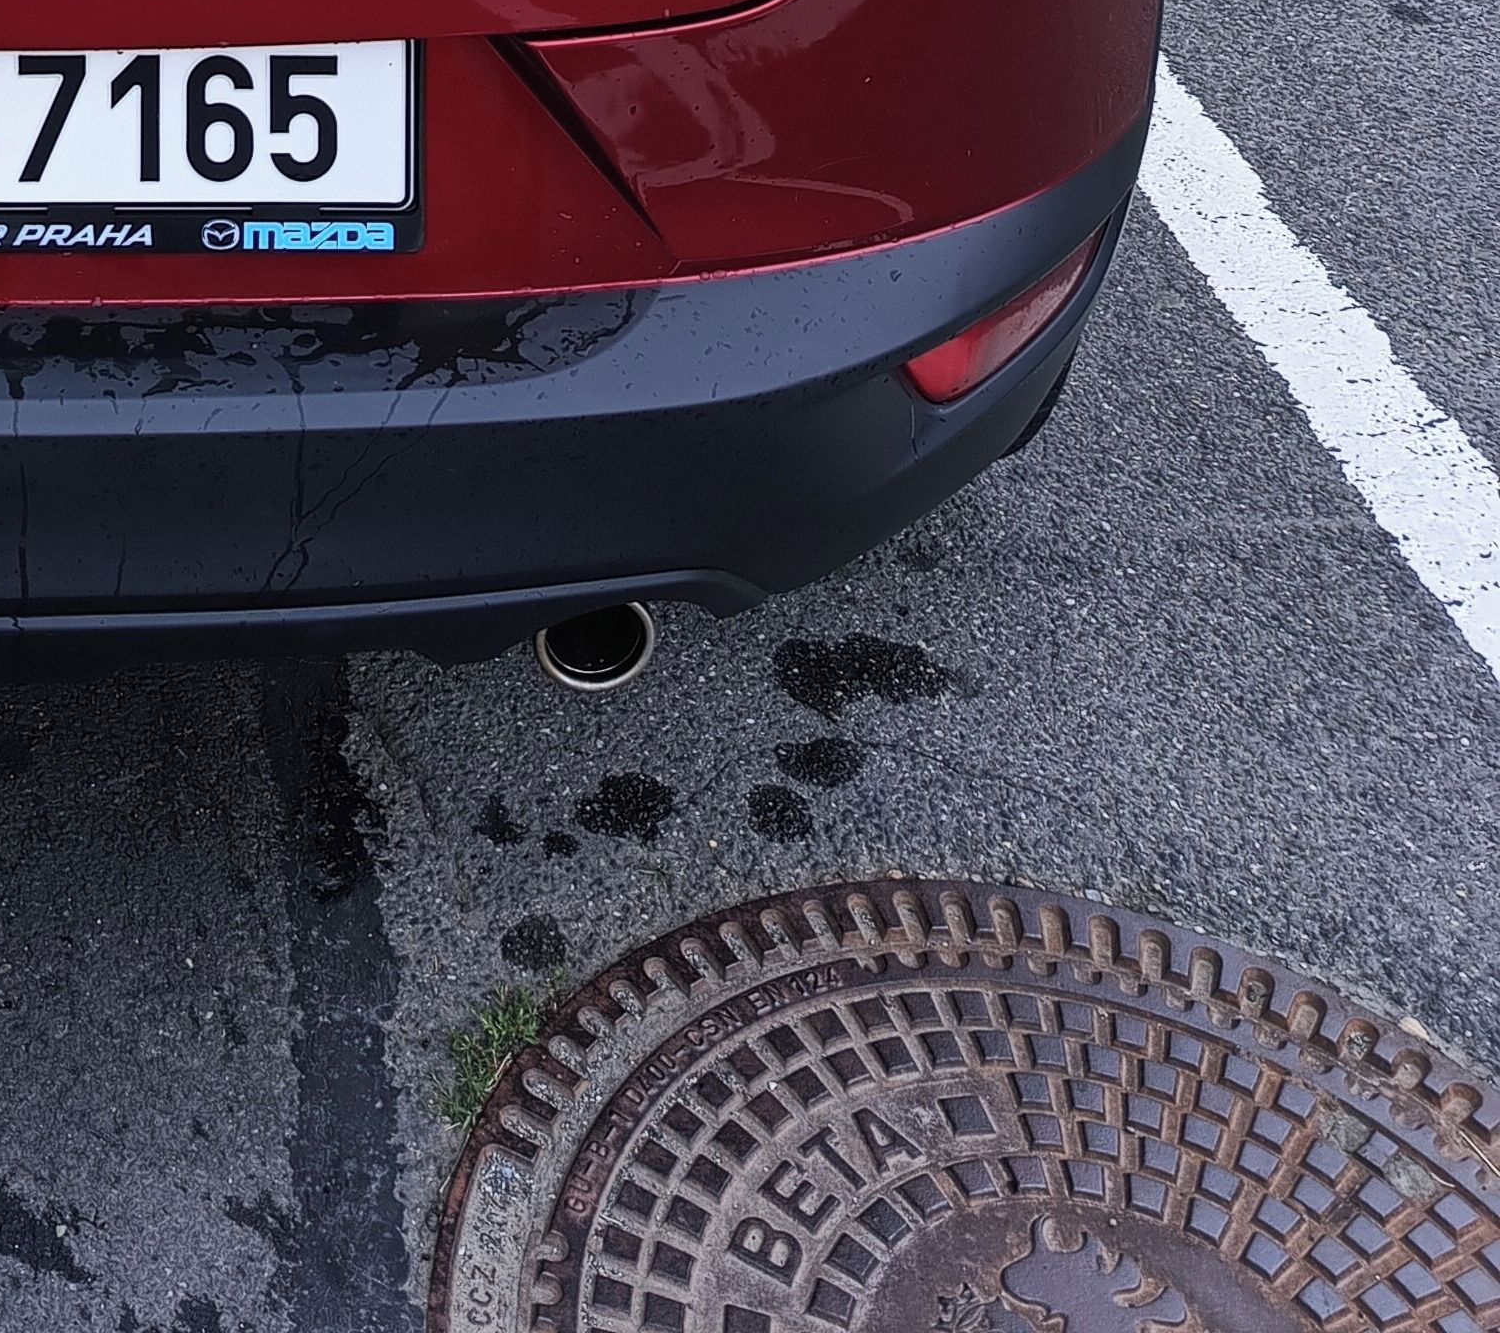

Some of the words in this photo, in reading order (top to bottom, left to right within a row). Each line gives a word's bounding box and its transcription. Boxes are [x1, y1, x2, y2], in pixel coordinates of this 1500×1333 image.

[16, 54, 339, 184] 7165
[14, 223, 155, 248] PRAHA
[726, 1106, 925, 1289] BETA
